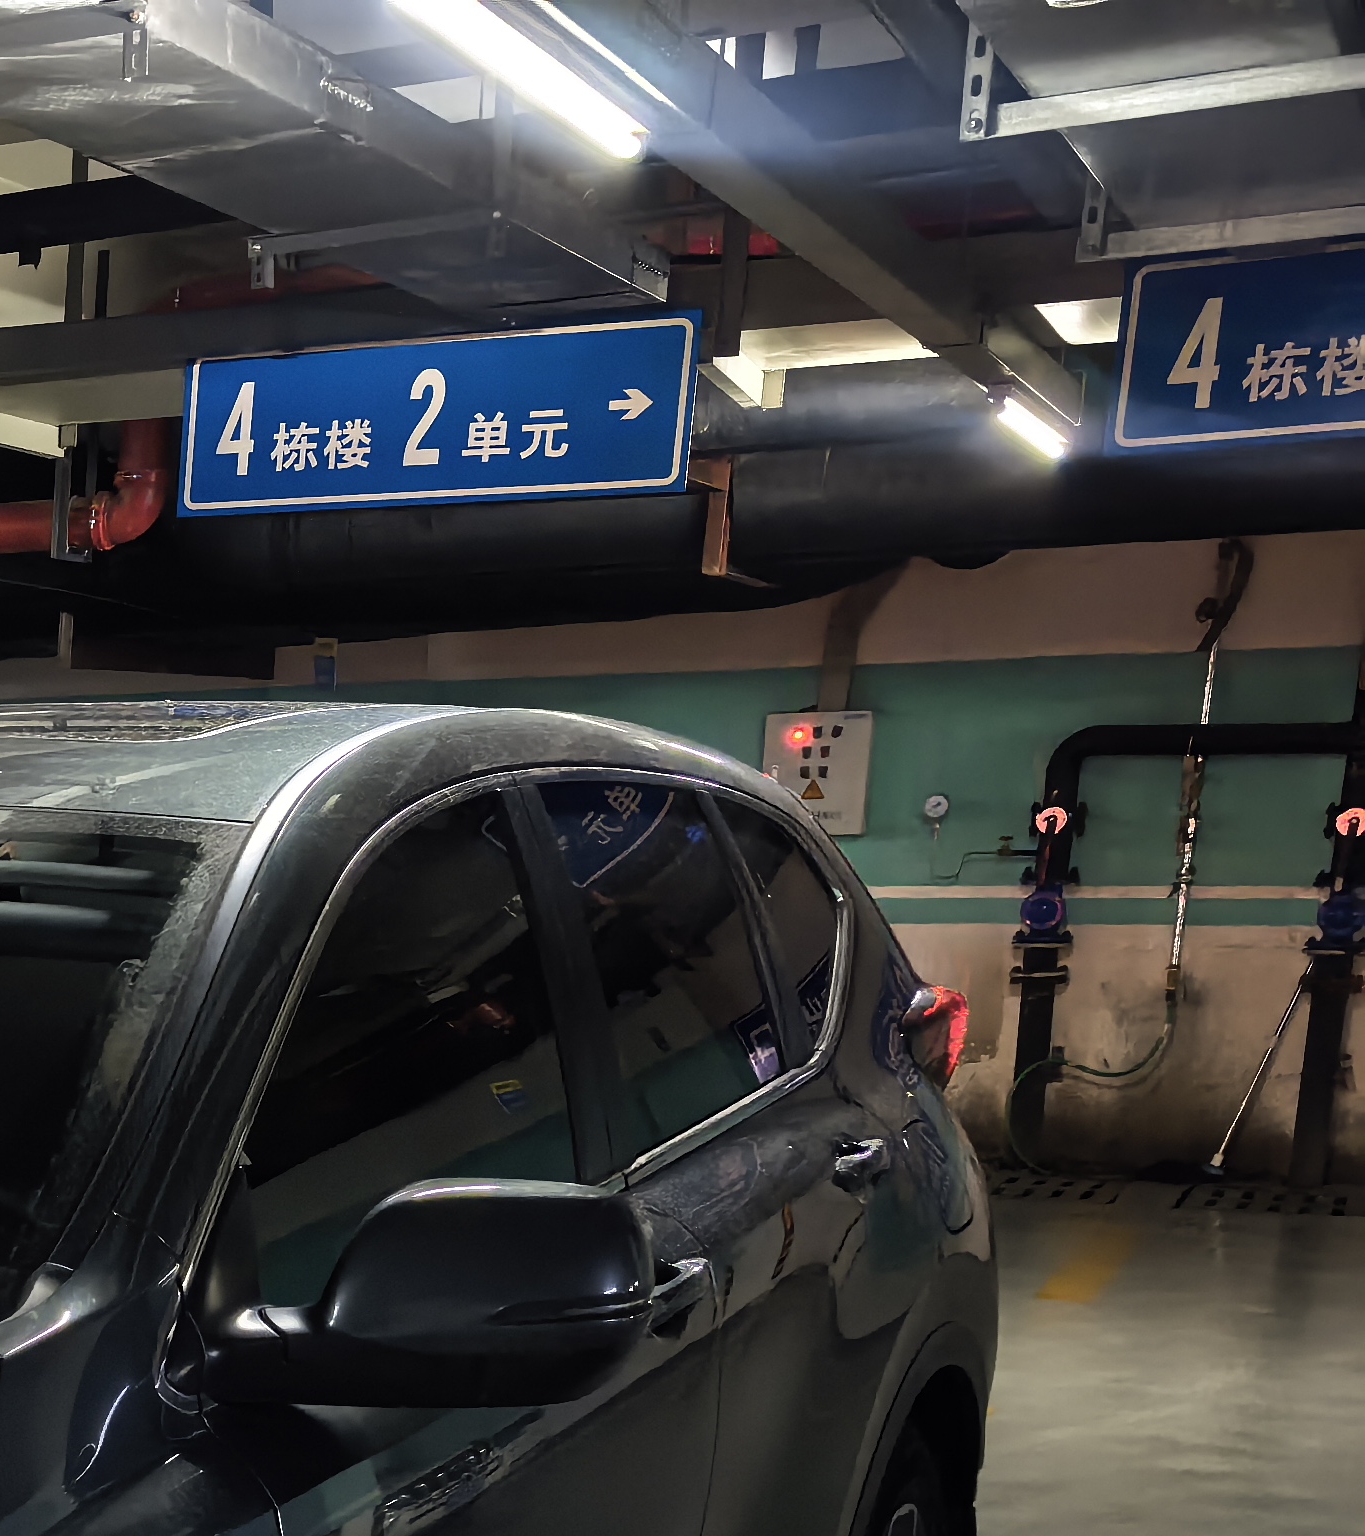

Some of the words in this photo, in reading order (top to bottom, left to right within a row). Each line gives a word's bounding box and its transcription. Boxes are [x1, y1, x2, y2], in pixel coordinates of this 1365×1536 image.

[1167, 297, 1223, 409] 4
[215, 382, 256, 476] 4
[270, 418, 372, 472] 栋楼
[403, 368, 447, 467] 2
[461, 409, 569, 462] 单元
